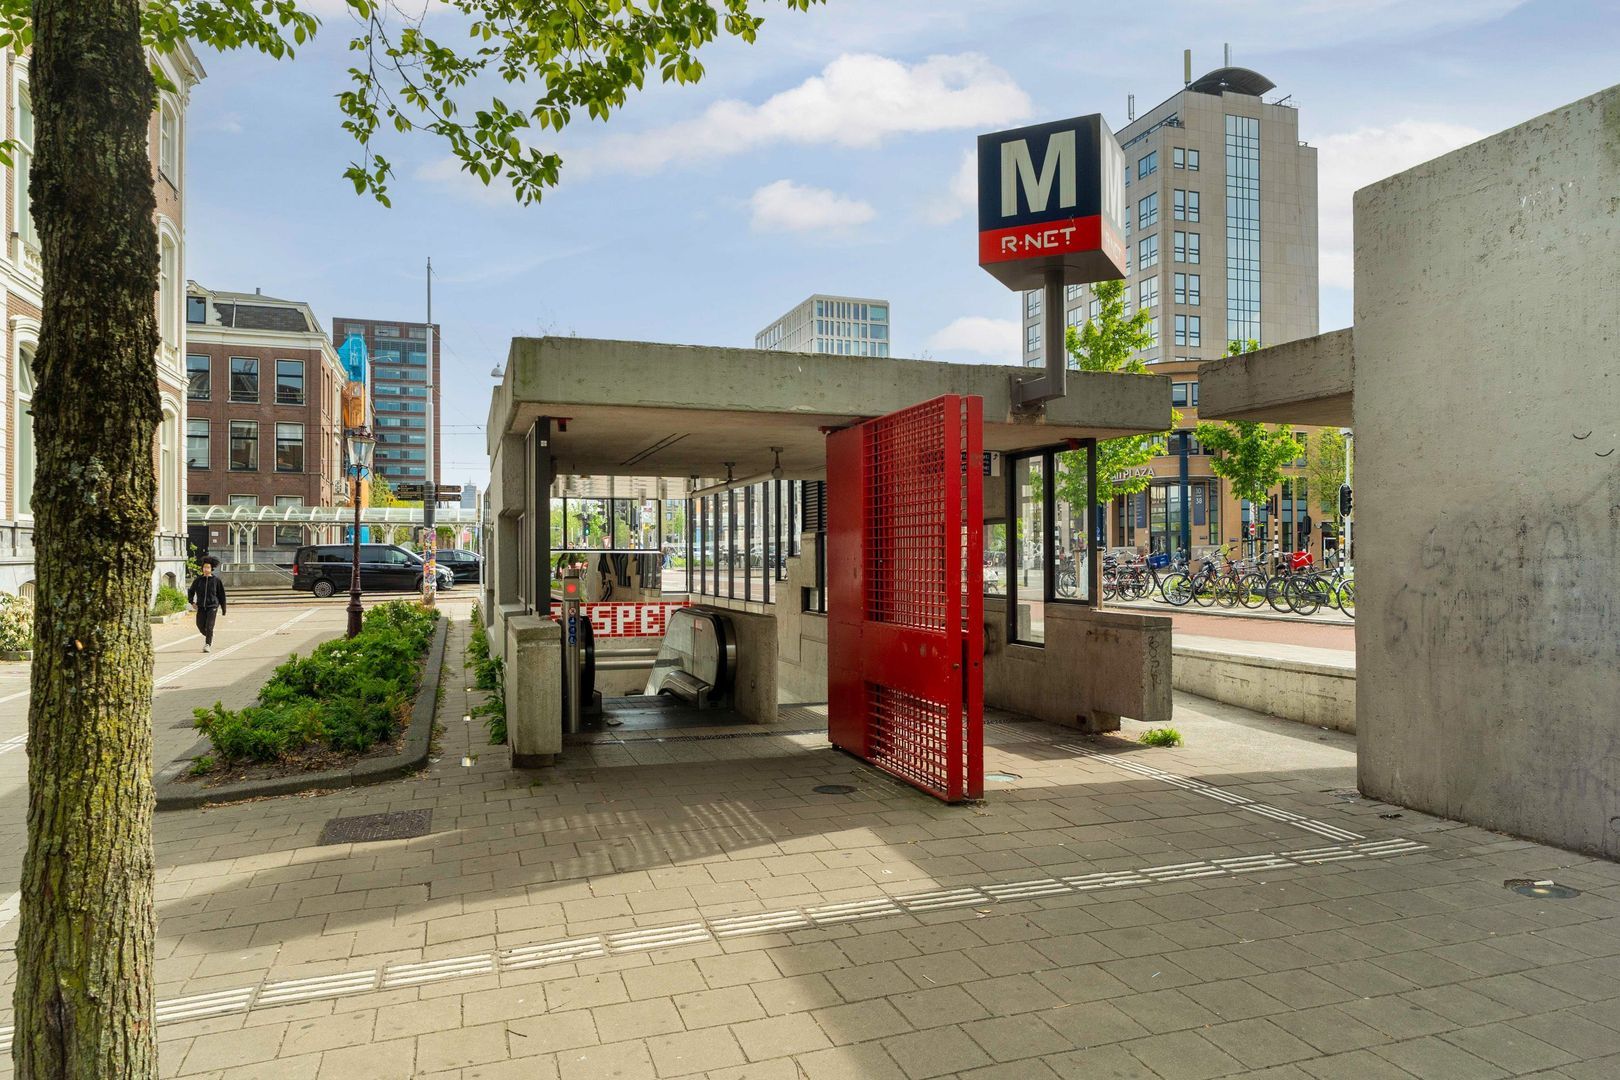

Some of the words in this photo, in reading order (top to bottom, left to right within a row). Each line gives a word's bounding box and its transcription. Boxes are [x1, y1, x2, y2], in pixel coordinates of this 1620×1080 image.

[1001, 130, 1077, 218] M
[1105, 134, 1121, 229] M
[1123, 467, 1155, 479] PLAZA
